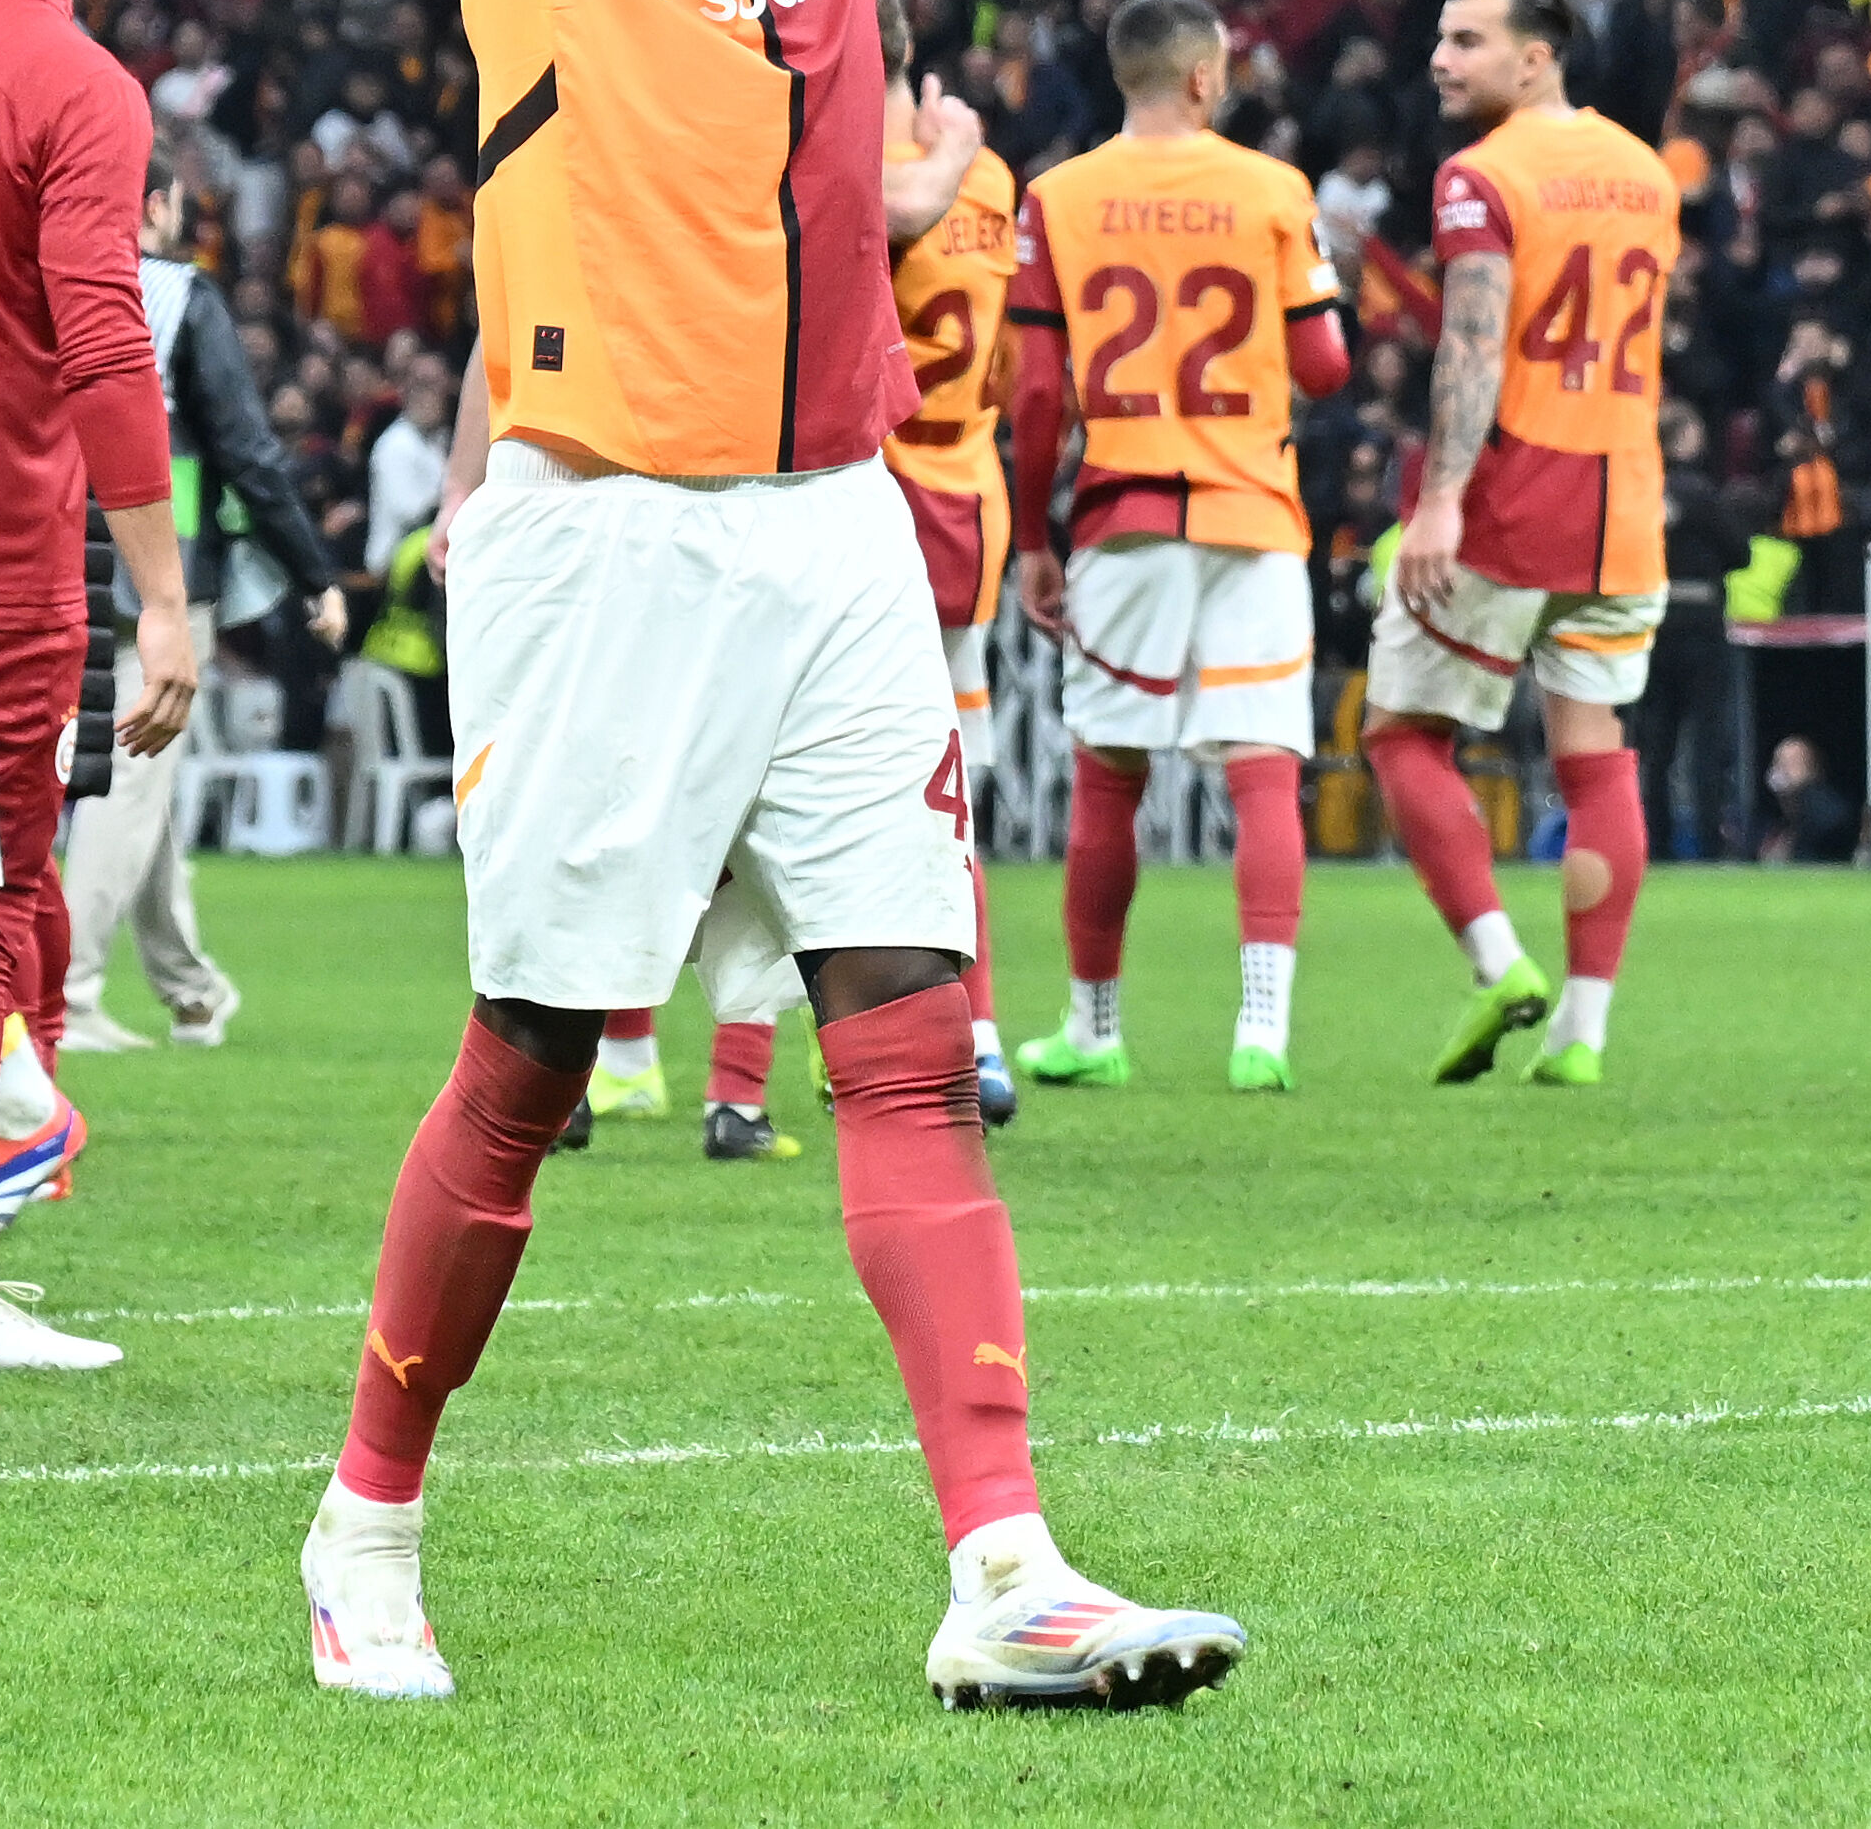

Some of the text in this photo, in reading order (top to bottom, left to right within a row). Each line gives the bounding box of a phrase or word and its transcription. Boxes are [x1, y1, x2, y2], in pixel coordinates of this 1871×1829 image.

[1100, 196, 1237, 237] ZIYECH
[1079, 264, 1257, 418] 22
[1519, 243, 1660, 394] 42
